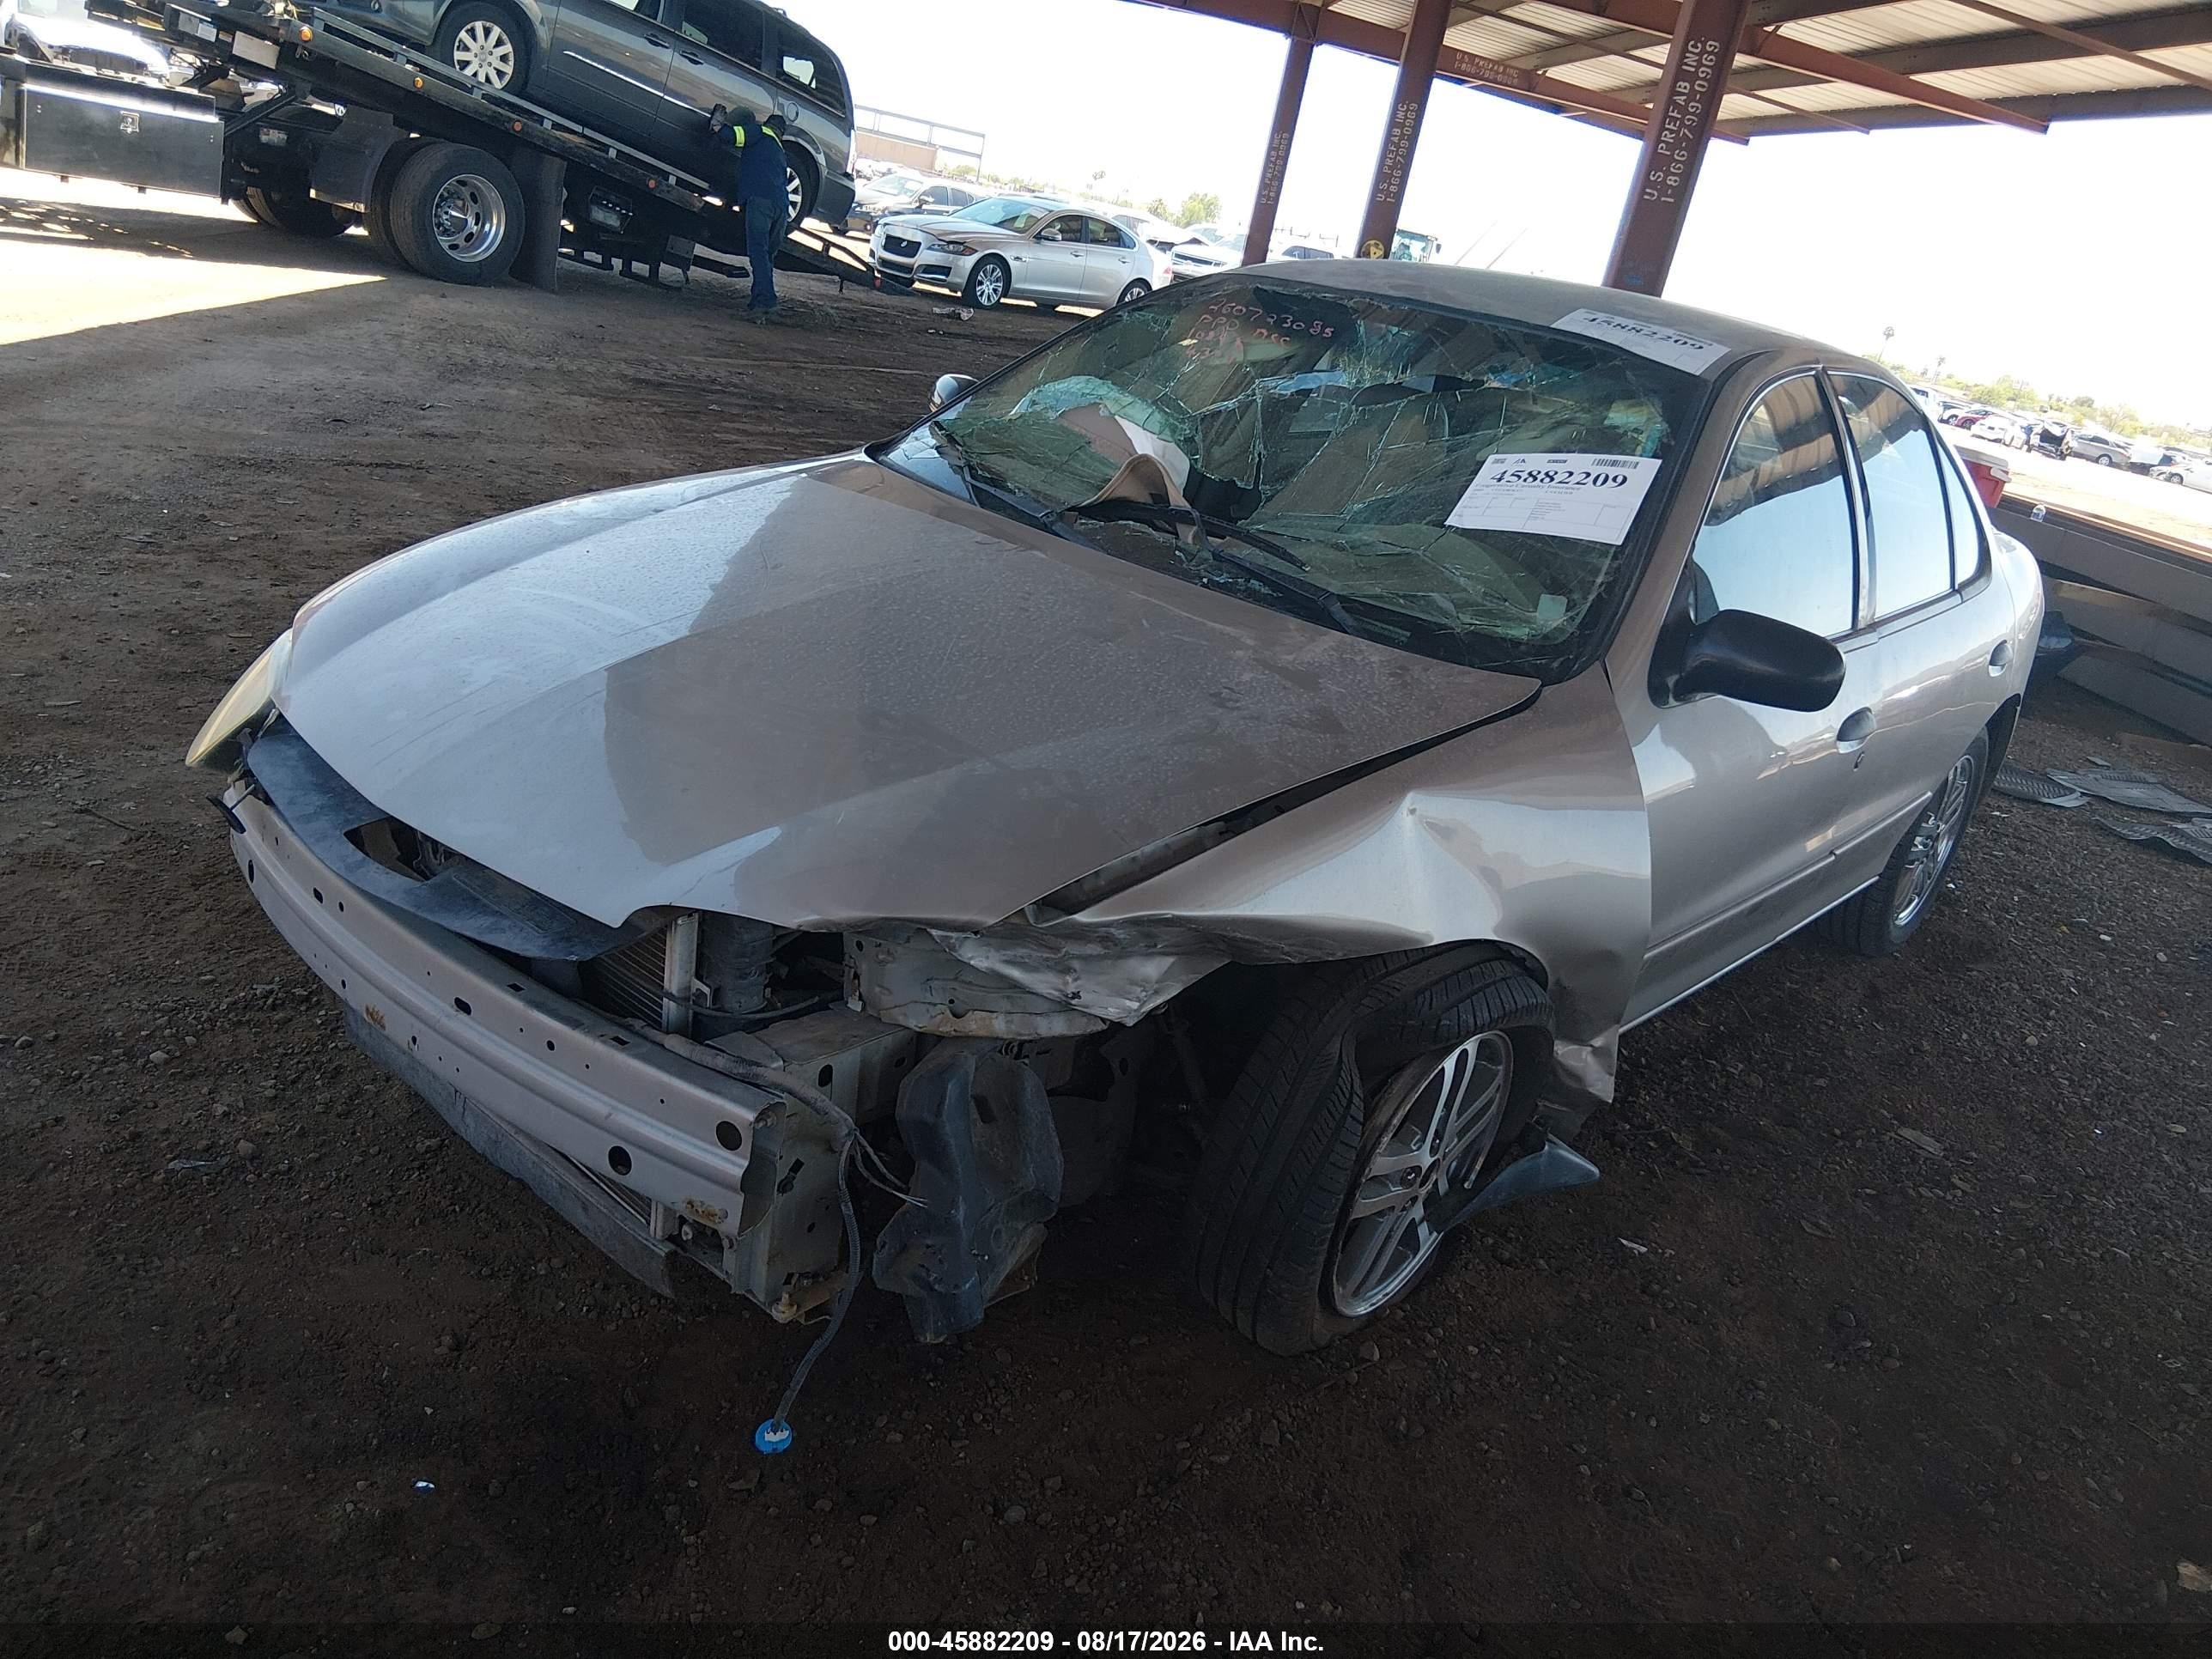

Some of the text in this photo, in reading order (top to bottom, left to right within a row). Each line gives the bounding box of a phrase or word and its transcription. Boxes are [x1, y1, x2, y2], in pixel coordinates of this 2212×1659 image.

[1376, 100, 1409, 202] U.S. PREFAB INC.
[1386, 102, 1419, 203] 1-866-799-0969
[1644, 37, 1705, 201] U.S. PREFAB INC.
[1661, 40, 1721, 203] 1-866-799-0969
[1490, 469, 1628, 488] 45882209
